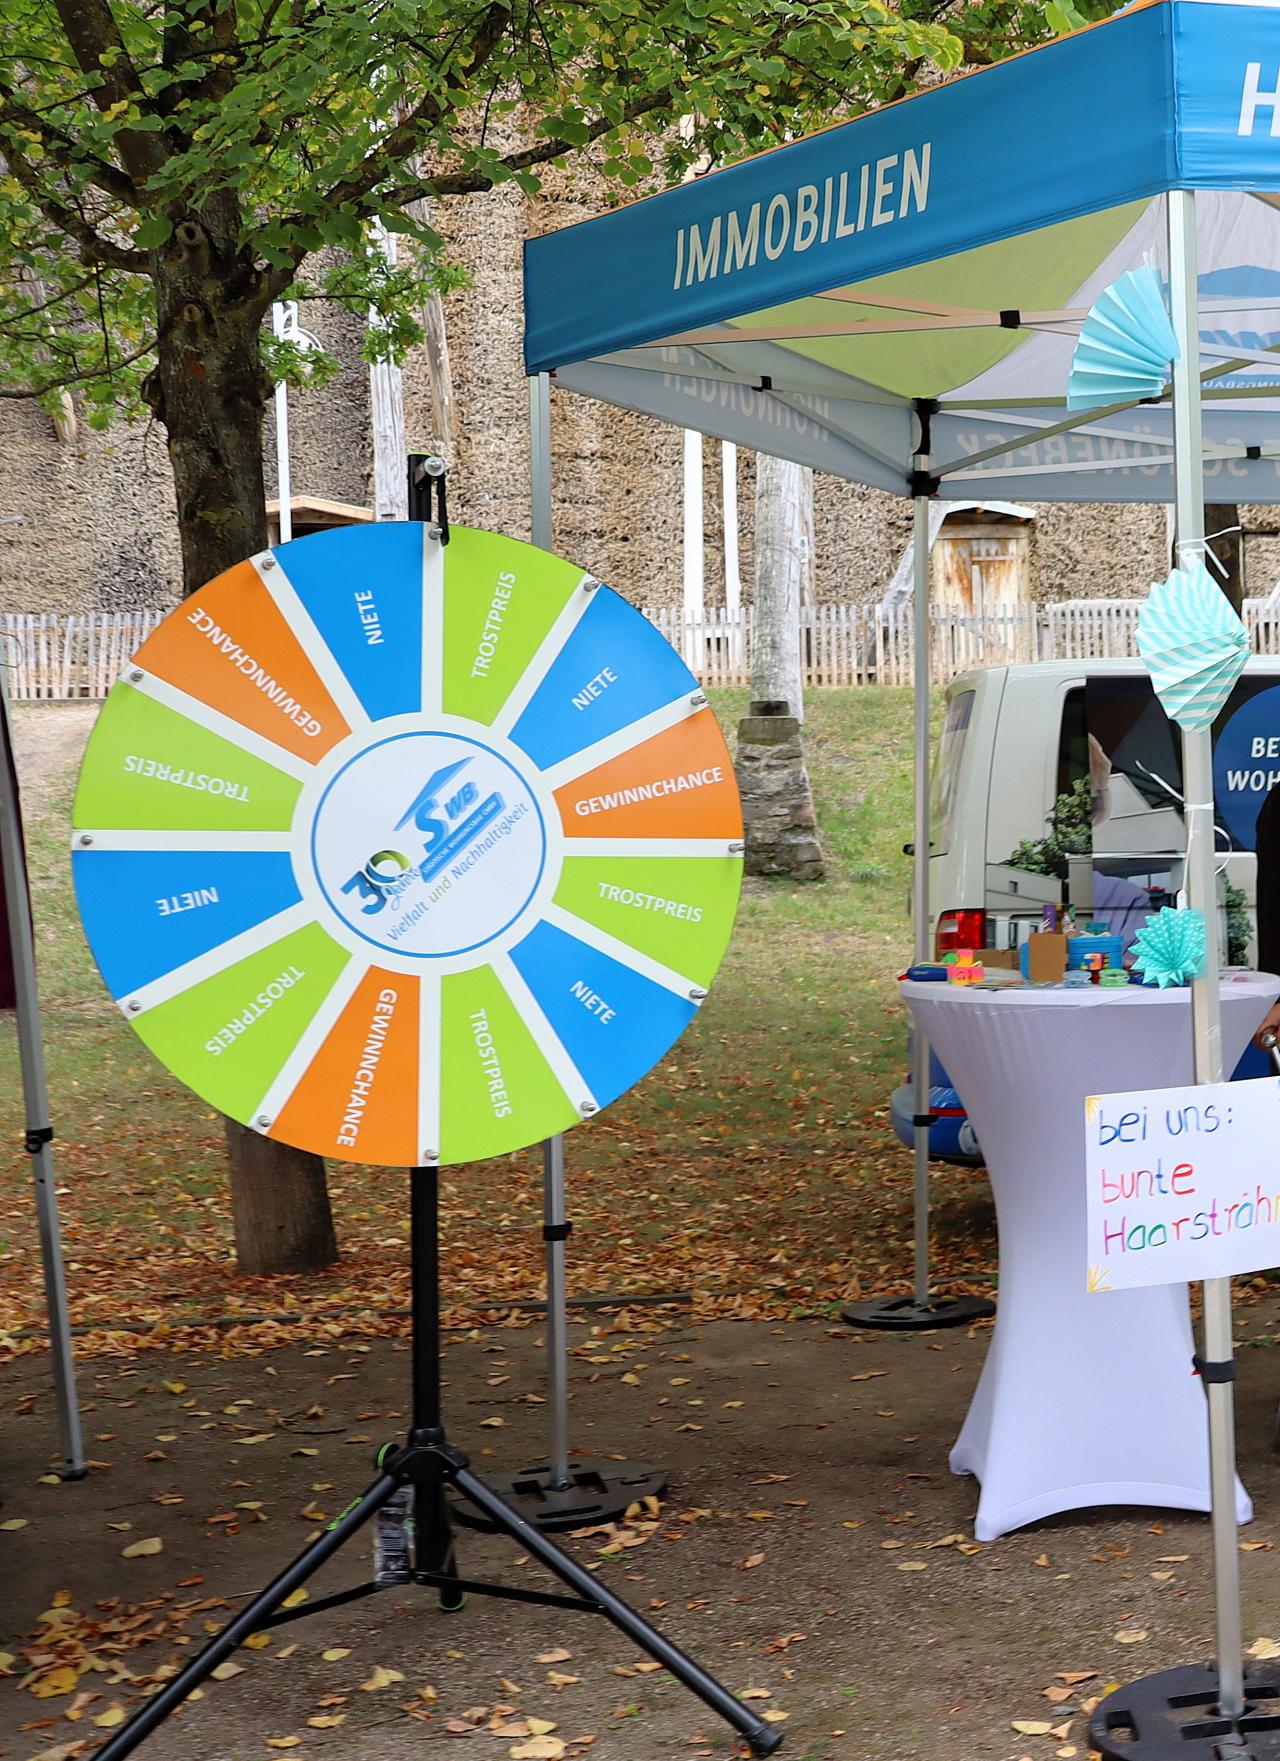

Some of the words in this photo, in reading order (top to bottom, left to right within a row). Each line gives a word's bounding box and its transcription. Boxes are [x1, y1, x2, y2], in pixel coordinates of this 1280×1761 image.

[672, 142, 931, 292] IMMOBILIEN
[355, 591, 384, 645] NIETE
[470, 571, 517, 678] TROSTPREIS
[188, 609, 322, 736] GEWINNCHANCE
[572, 667, 617, 711] NIETE
[123, 755, 250, 803] TROSTPREIS
[575, 767, 724, 817] GEWINNCHANCE
[340, 850, 410, 915] 30
[386, 901, 429, 941] Vielfalt
[428, 876, 452, 904] und
[450, 802, 529, 880] Nachhaltigkeit
[157, 888, 218, 916] NIETE
[599, 882, 703, 923] TROSTPREIS
[205, 967, 304, 1056] TROSTPREIS
[571, 981, 615, 1024] NIETE
[337, 988, 398, 1147] GEWINNCHANCE
[469, 1008, 511, 1119] TROSTPREIS
[1099, 1106, 1147, 1146] bei
[1166, 1104, 1232, 1136] uns:
[1101, 1158, 1196, 1204] bunte
